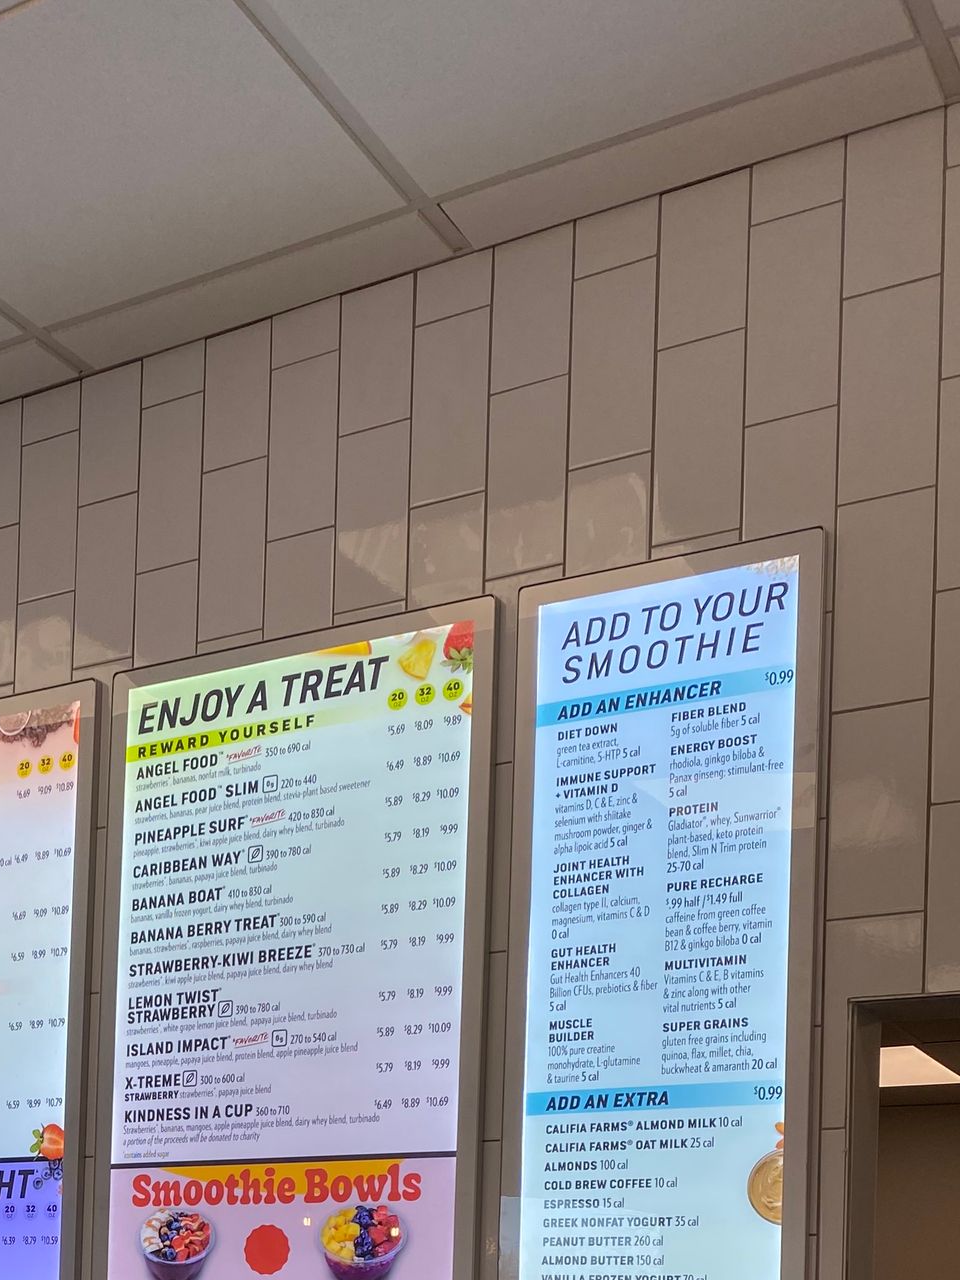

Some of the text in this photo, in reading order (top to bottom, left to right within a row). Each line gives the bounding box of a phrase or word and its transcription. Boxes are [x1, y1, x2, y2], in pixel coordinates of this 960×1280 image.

[561, 581, 789, 651] ADD TO YOUR
[562, 621, 764, 684] SMOOTHIE
[446, 681, 461, 692] 40
[765, 669, 794, 686] $0.99
[137, 655, 390, 736] ENJOY A TREAT
[391, 691, 405, 702] 20
[418, 686, 432, 697] 32
[557, 680, 722, 721] ADD AN ENHANCER
[671, 701, 746, 723] FIBER BLEND
[557, 722, 618, 741] DIET DOWN
[670, 712, 761, 739] 5g of soluble fiber 5 cal
[137, 714, 315, 759] REWARD YOURSELF
[670, 734, 758, 756] ENERGY BOOST
[61, 753, 73, 763] 40
[264, 740, 311, 758] 350 to 690 cal
[19, 761, 30, 771] 20
[40, 757, 51, 767] 32
[225, 779, 259, 798] SLIM
[668, 801, 719, 818] PROTEIN
[134, 822, 206, 846] PINEAPPLE
[133, 855, 208, 879] CARIBBEAN
[132, 892, 185, 912] BANANA
[128, 950, 254, 978] STRAWBERRY-KIWI
[664, 954, 747, 971] MULTIVITAMIN
[127, 1003, 216, 1025] STRAWBERRY
[662, 1017, 749, 1033] SUPER GRAINS
[124, 1073, 181, 1090] X-TREME
[545, 1090, 669, 1112] ADD AN EXTRA
[753, 1085, 783, 1101] $0.99
[124, 1103, 253, 1124] KINDNESS IN A CUP
[544, 1159, 629, 1172] ALMONDS 100 cal
[131, 1163, 422, 1208] Smoothie Bowls
[544, 1197, 625, 1209] ESPRESSO 15 cal
